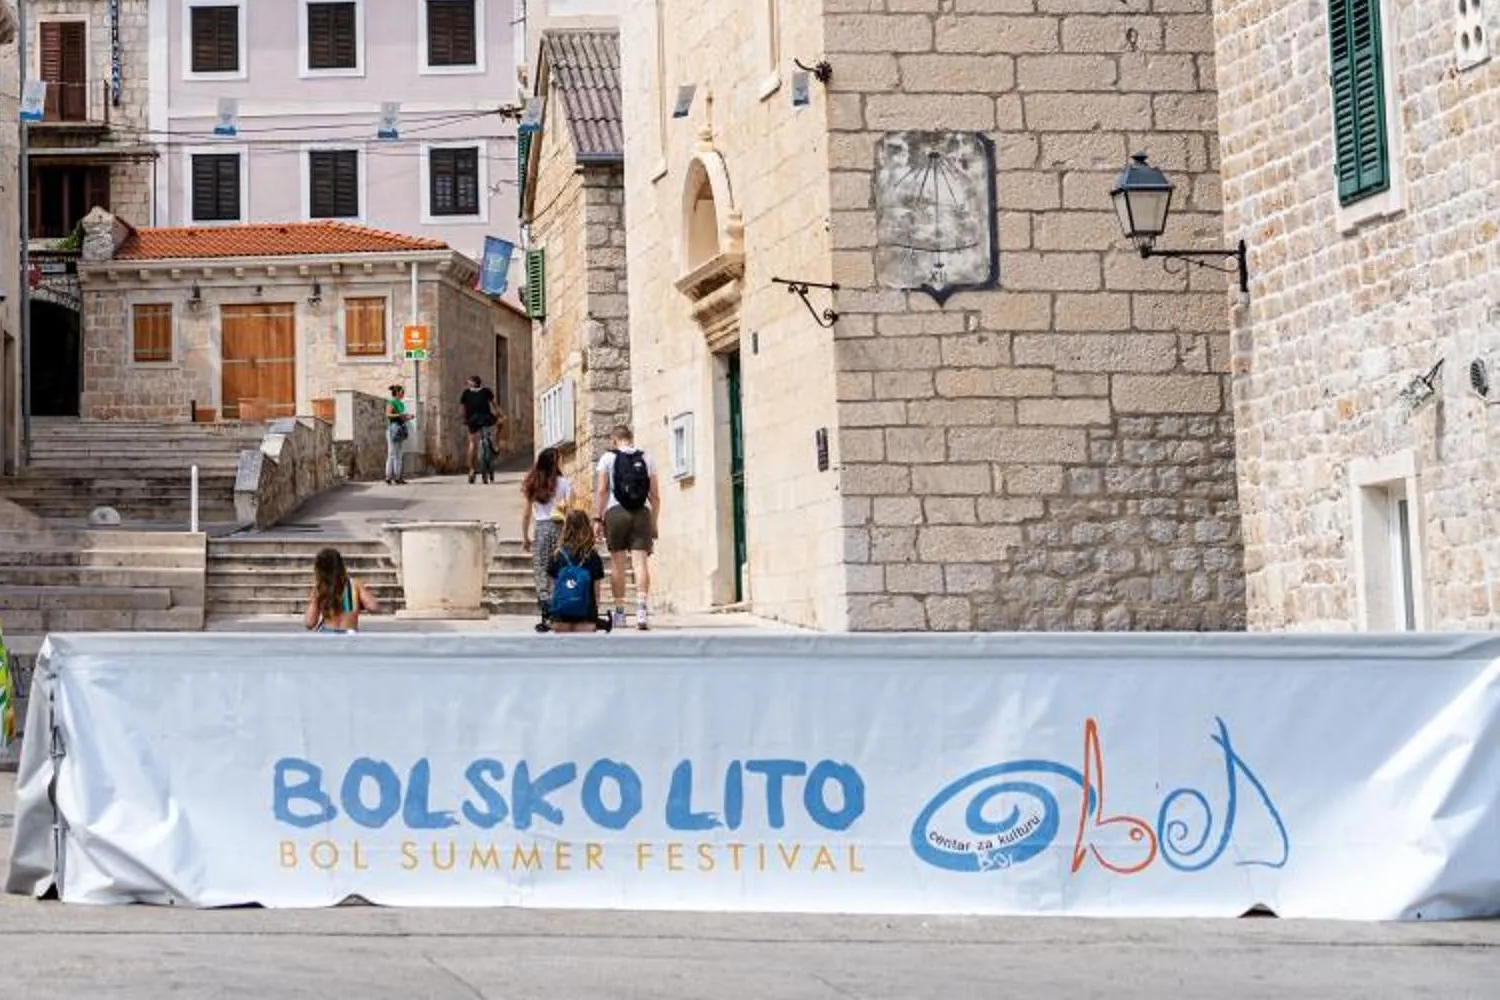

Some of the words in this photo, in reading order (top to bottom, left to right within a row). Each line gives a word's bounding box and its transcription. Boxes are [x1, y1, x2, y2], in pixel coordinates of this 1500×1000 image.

[273, 757, 643, 830] BOLSKO
[665, 758, 866, 831] LITO
[929, 831, 971, 851] centar
[977, 840, 993, 851] za
[999, 815, 1041, 845] kulturu
[279, 840, 369, 870] BOL
[403, 841, 605, 871] SUMMER
[637, 843, 866, 873] FESTIVAL
